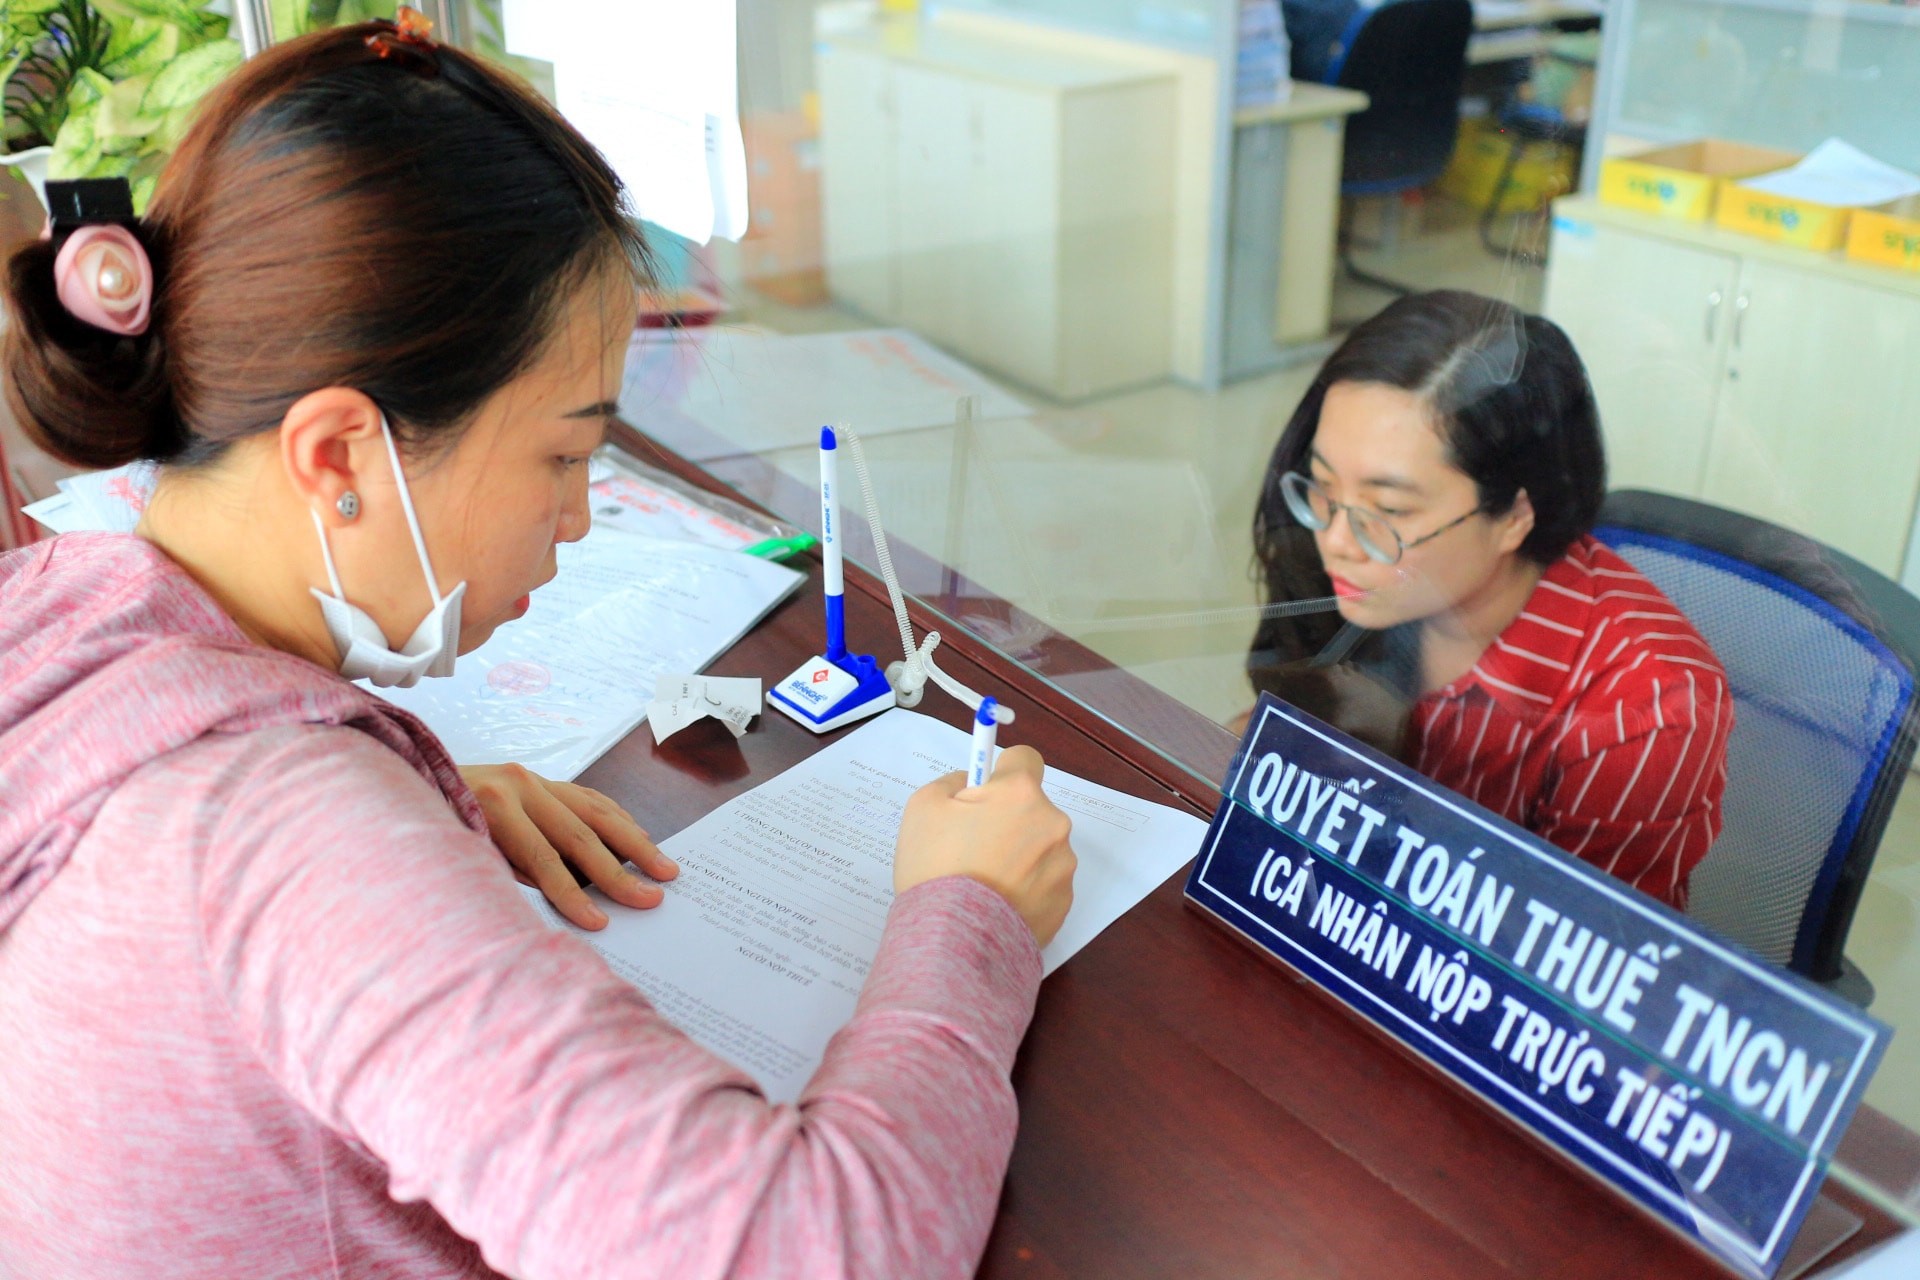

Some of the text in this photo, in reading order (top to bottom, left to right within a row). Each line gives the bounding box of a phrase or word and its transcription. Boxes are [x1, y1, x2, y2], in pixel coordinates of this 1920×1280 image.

[1248, 752, 1830, 1136] QUYẾT TOÁN THUẾ TNCN
[1250, 847, 1731, 1192] (CÁ NHÂN NỘP TRỰC TIẾP)
